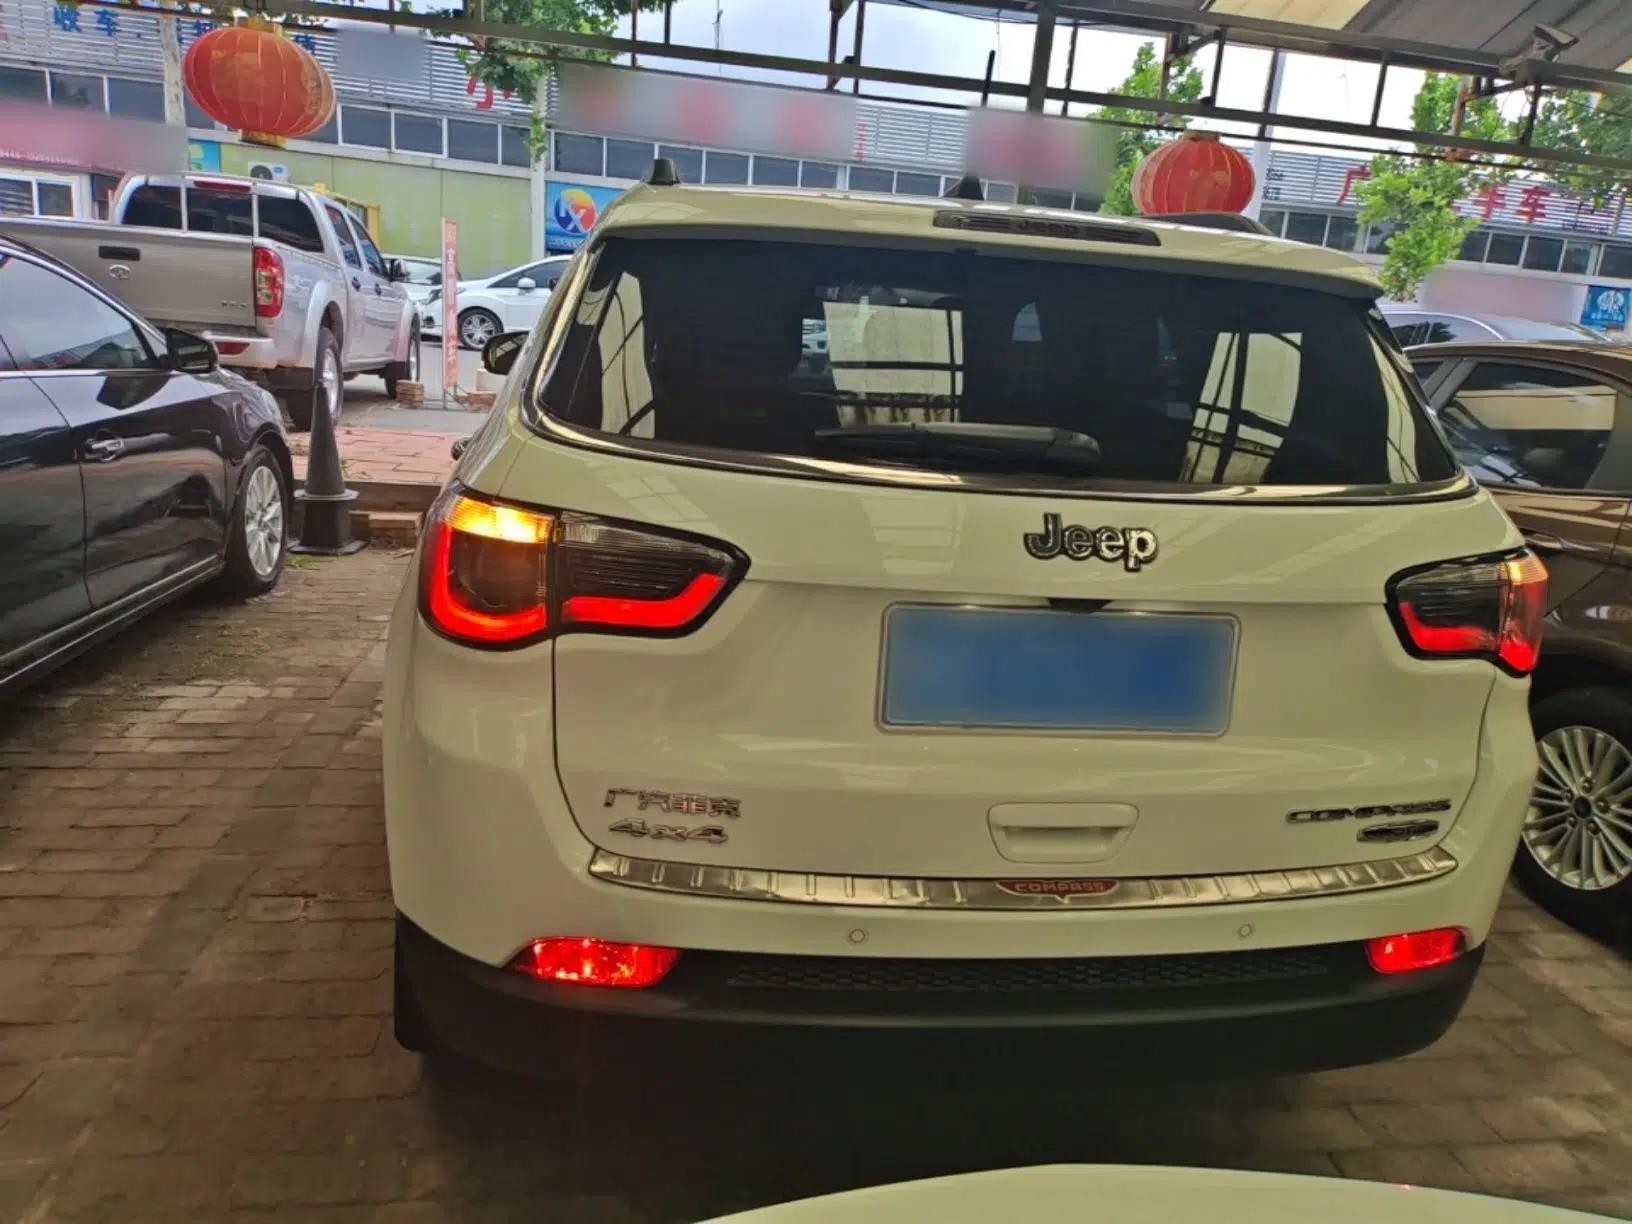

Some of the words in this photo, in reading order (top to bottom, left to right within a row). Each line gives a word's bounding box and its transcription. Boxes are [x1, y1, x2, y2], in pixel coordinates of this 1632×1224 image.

[1023, 512, 1159, 573] Jeep
[604, 788, 741, 819] 广汽菲克
[1014, 881, 1106, 893] COMPASS
